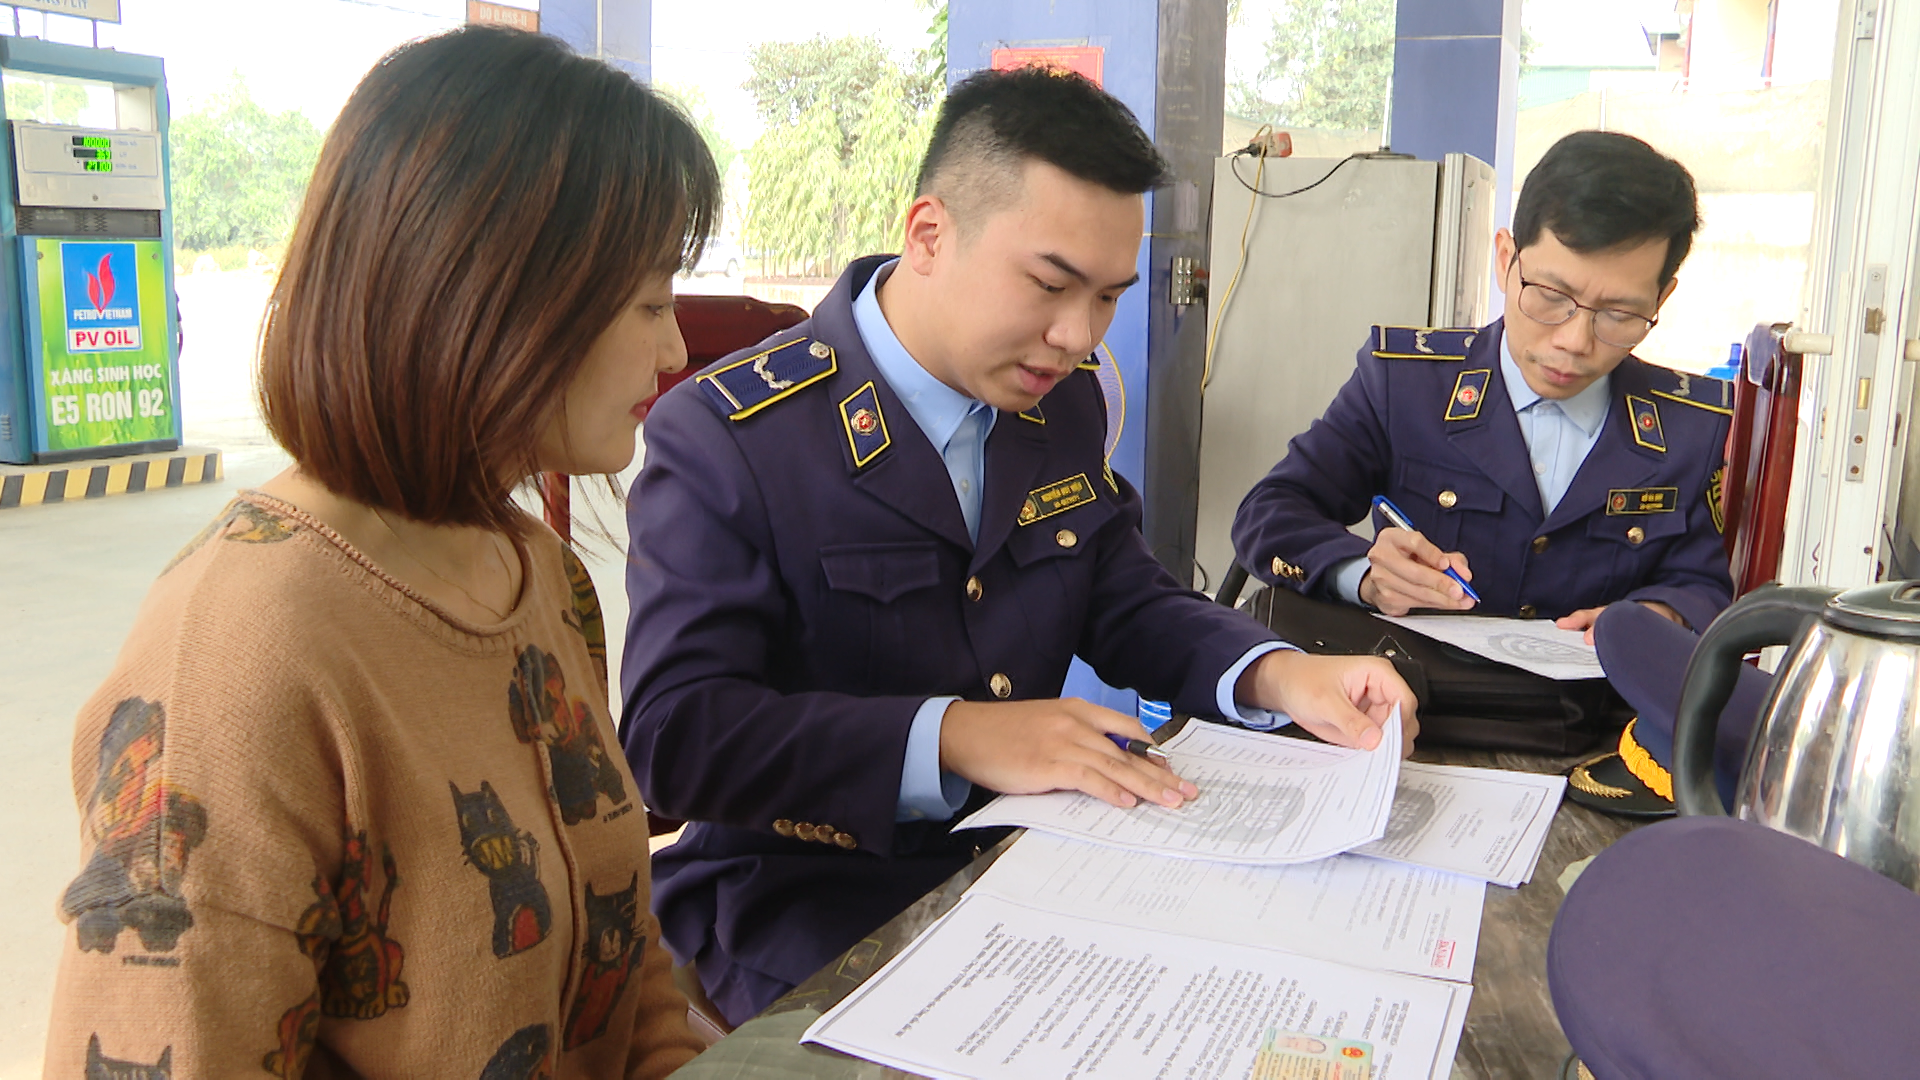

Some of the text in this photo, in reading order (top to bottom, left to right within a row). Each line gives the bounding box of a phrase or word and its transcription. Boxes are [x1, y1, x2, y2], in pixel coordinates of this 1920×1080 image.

[480, 5, 492, 20] DO
[74, 308, 132, 321] PETROVIETNAM
[75, 329, 134, 348] PV OIL
[97, 365, 129, 383] SINH
[132, 363, 163, 382] HỌC
[51, 387, 165, 426] E5 RON 92
